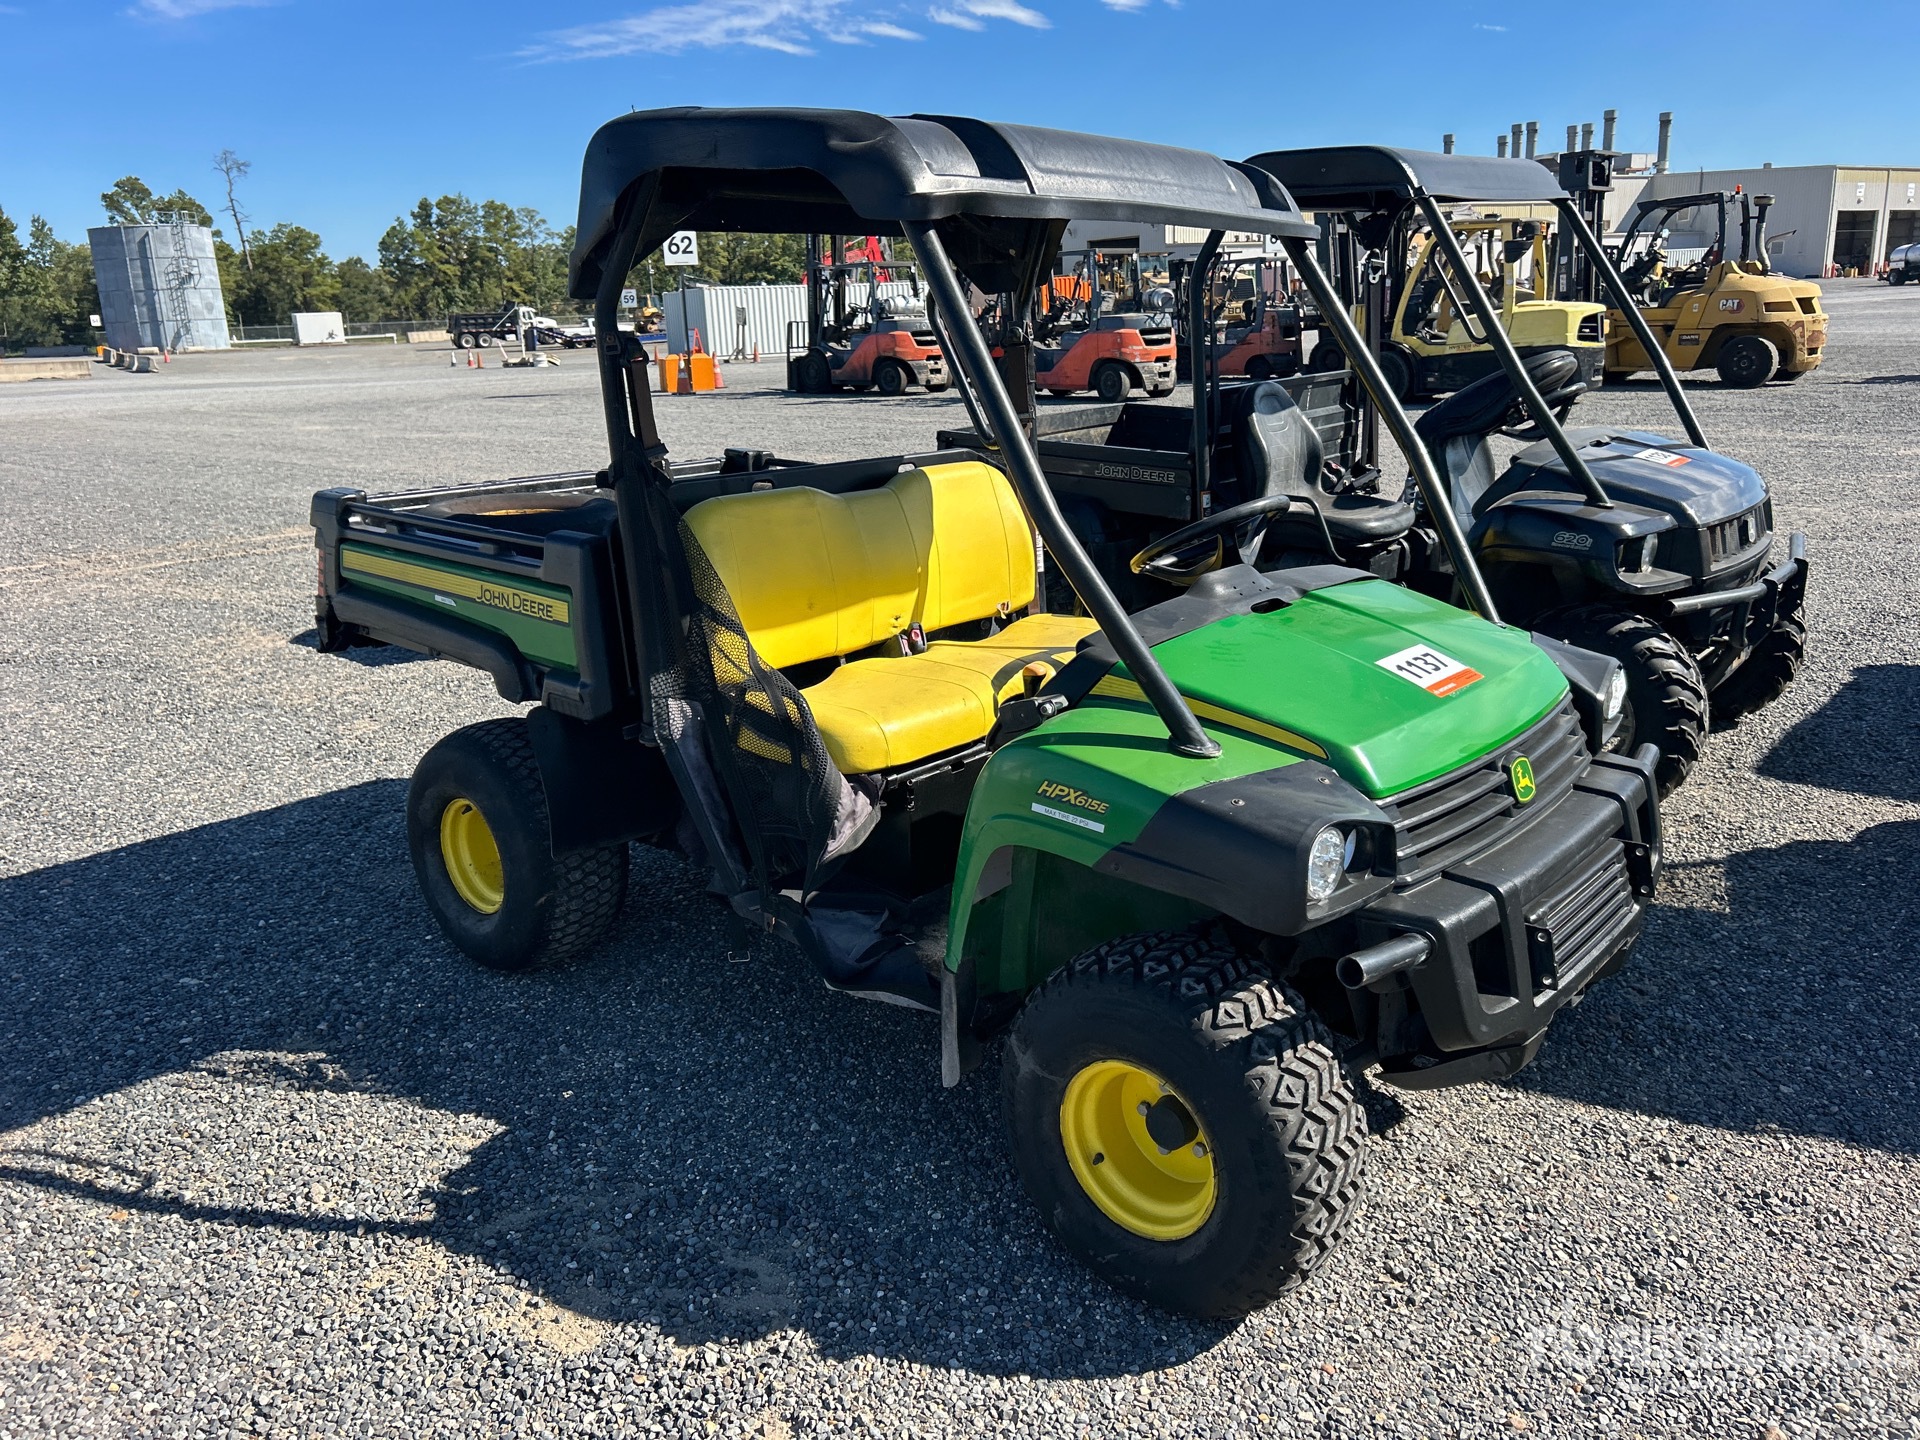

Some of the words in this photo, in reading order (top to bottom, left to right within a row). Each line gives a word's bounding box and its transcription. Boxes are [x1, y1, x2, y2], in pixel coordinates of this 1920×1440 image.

[667, 235, 694, 255] 62
[623, 294, 635, 304] 59
[1719, 299, 1740, 311] CAT
[1095, 463, 1130, 479] JOHN
[1130, 466, 1175, 483] DEERE
[476, 585, 510, 608] JOHN
[512, 593, 554, 619] DEERE
[1395, 652, 1449, 679] 1137
[1037, 780, 1110, 814] HPX615E
[1044, 807, 1057, 817] MAX
[1057, 810, 1070, 821] TIRE
[1079, 818, 1089, 827] PSI
